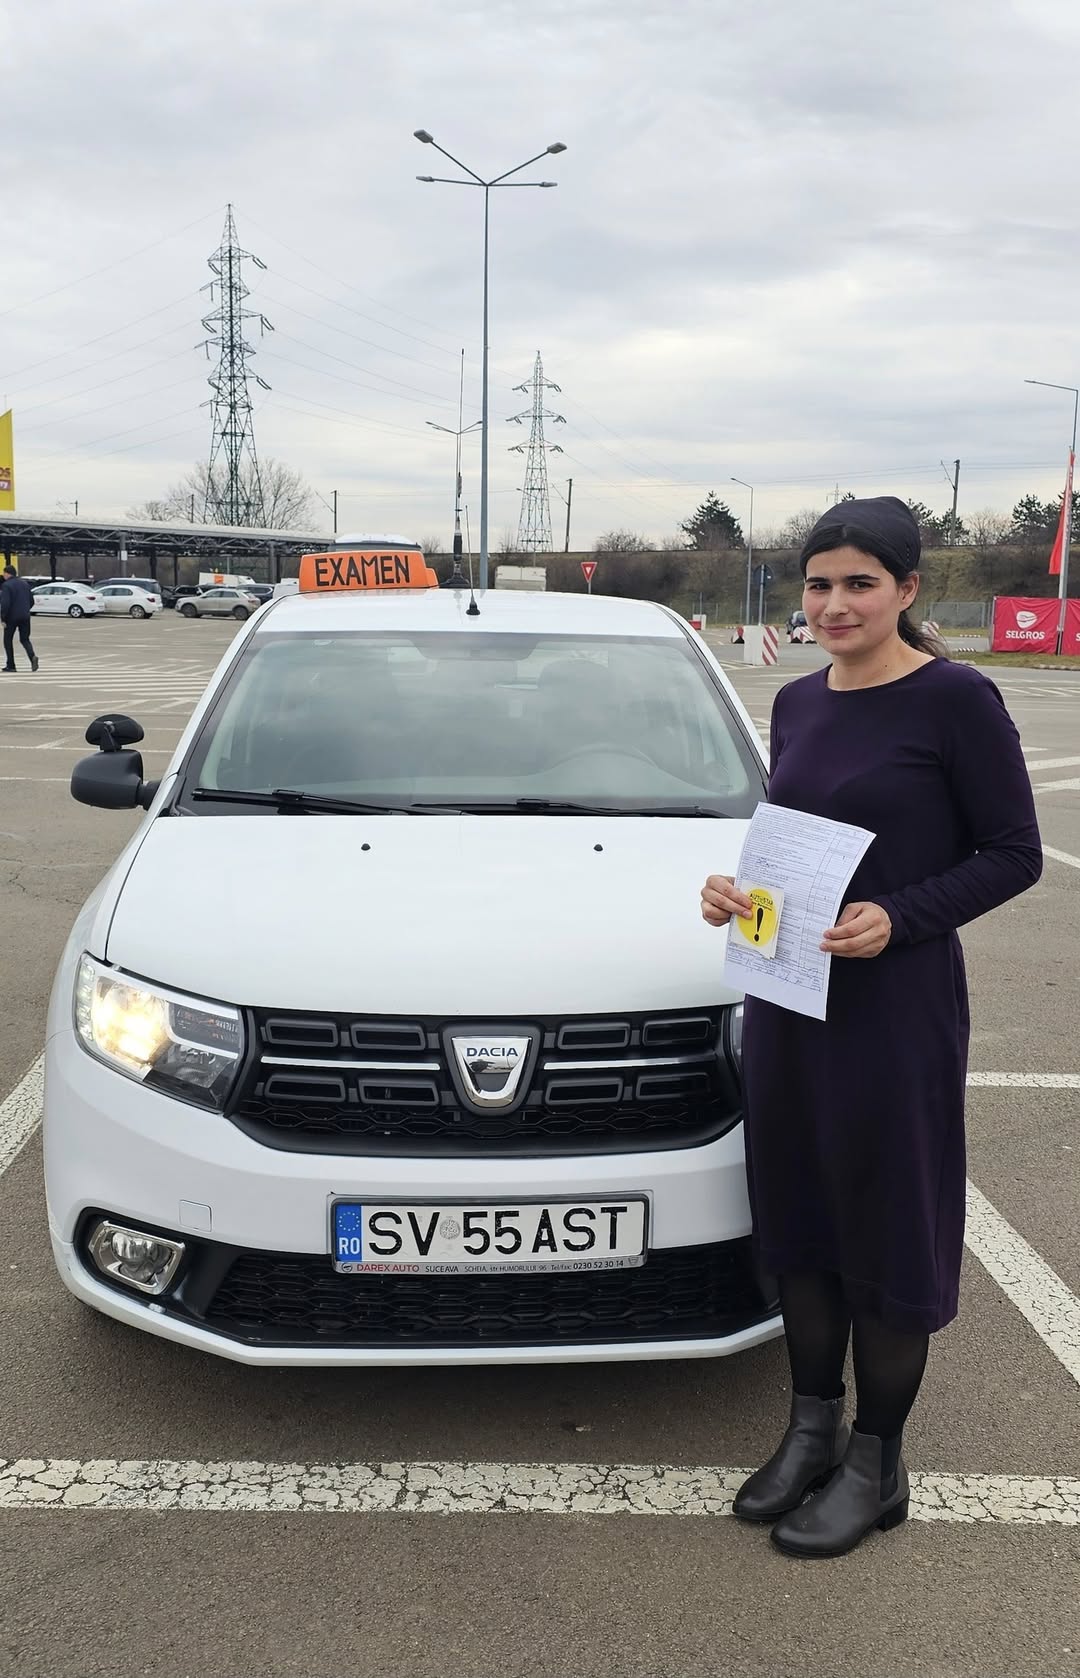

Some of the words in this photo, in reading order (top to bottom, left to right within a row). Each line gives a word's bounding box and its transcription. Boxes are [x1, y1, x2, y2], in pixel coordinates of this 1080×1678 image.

[315, 555, 410, 586] EXAMEN
[1005, 630, 1046, 640] SELGROS
[467, 1047, 518, 1057] DACIA
[368, 1211, 441, 1256] SV
[338, 1237, 361, 1255] RO
[357, 1264, 390, 1272] DAREX
[392, 1264, 420, 1272] AUTO
[425, 1265, 459, 1273] SUCEAVA
[573, 1262, 592, 1270] 0230
[593, 1261, 603, 1269] 52
[604, 1260, 614, 1268] 30
